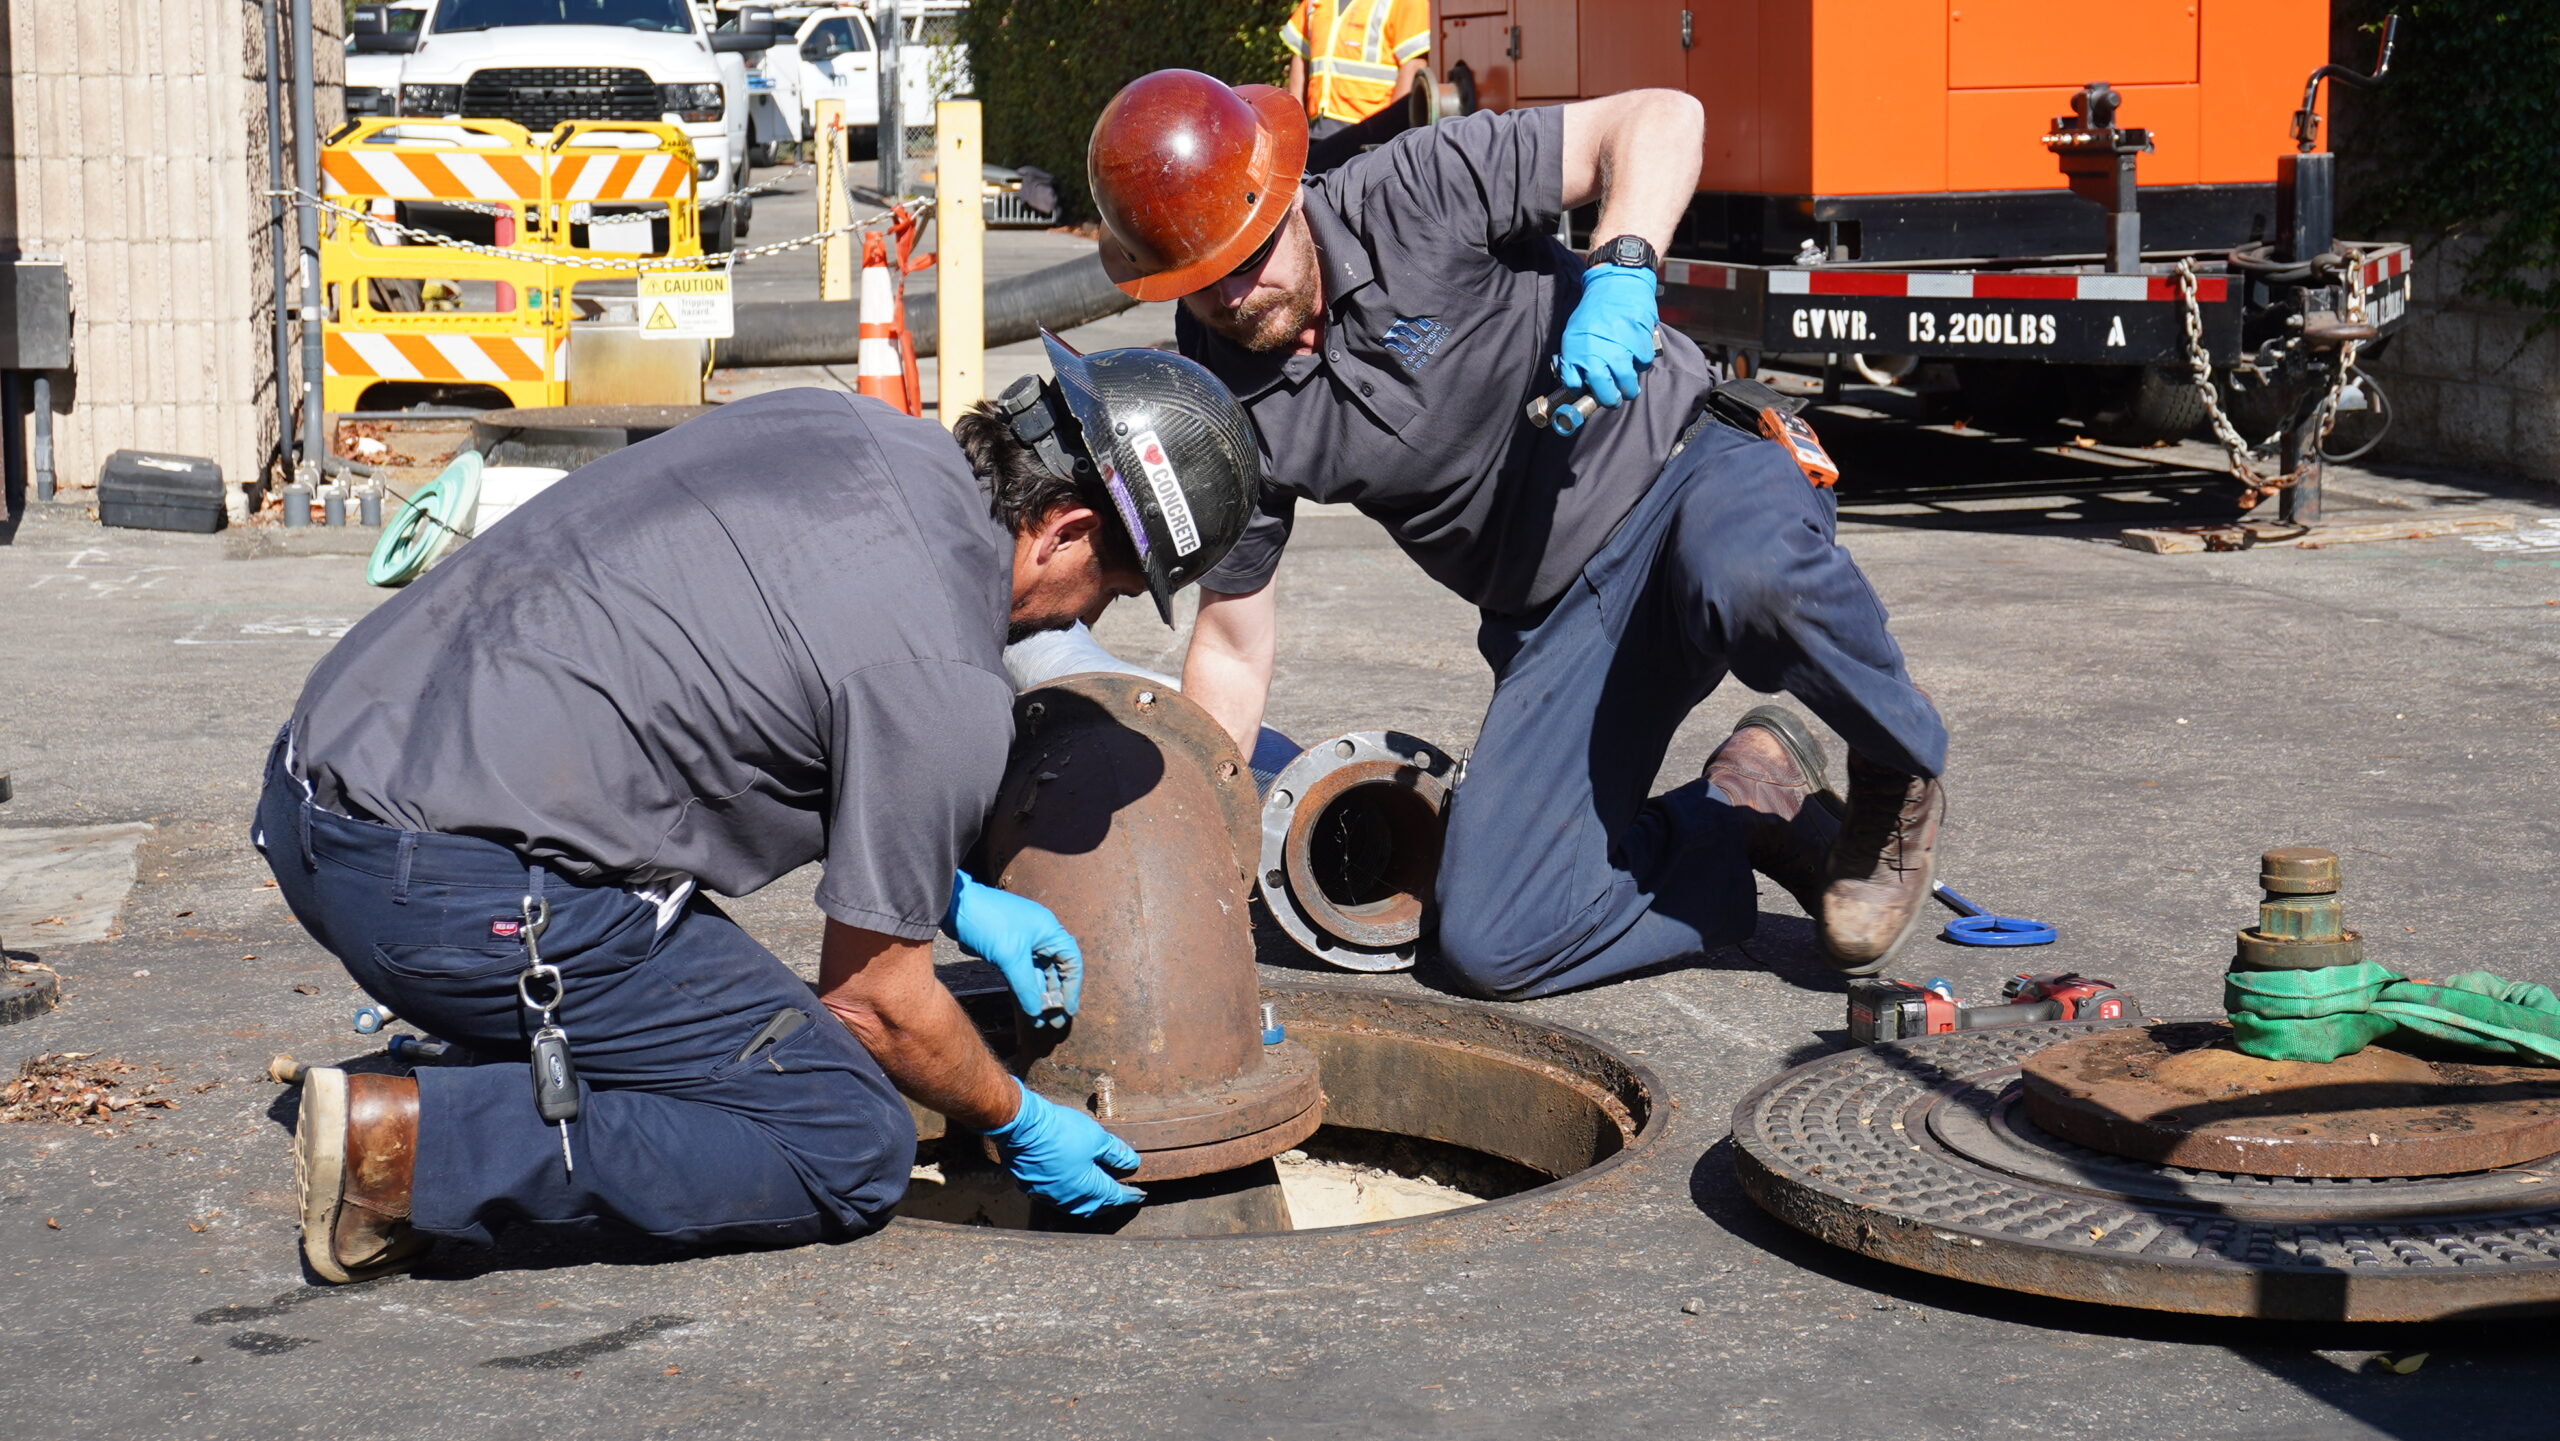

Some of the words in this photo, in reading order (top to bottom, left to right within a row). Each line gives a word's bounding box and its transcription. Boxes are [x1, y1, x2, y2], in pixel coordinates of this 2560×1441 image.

[664, 279, 724, 293] CAUTION
[681, 299, 715, 308] Tripping
[1792, 309, 1877, 341] GVWR.
[2107, 315, 2127, 347] A
[1152, 468, 1198, 554] CONCRETE
